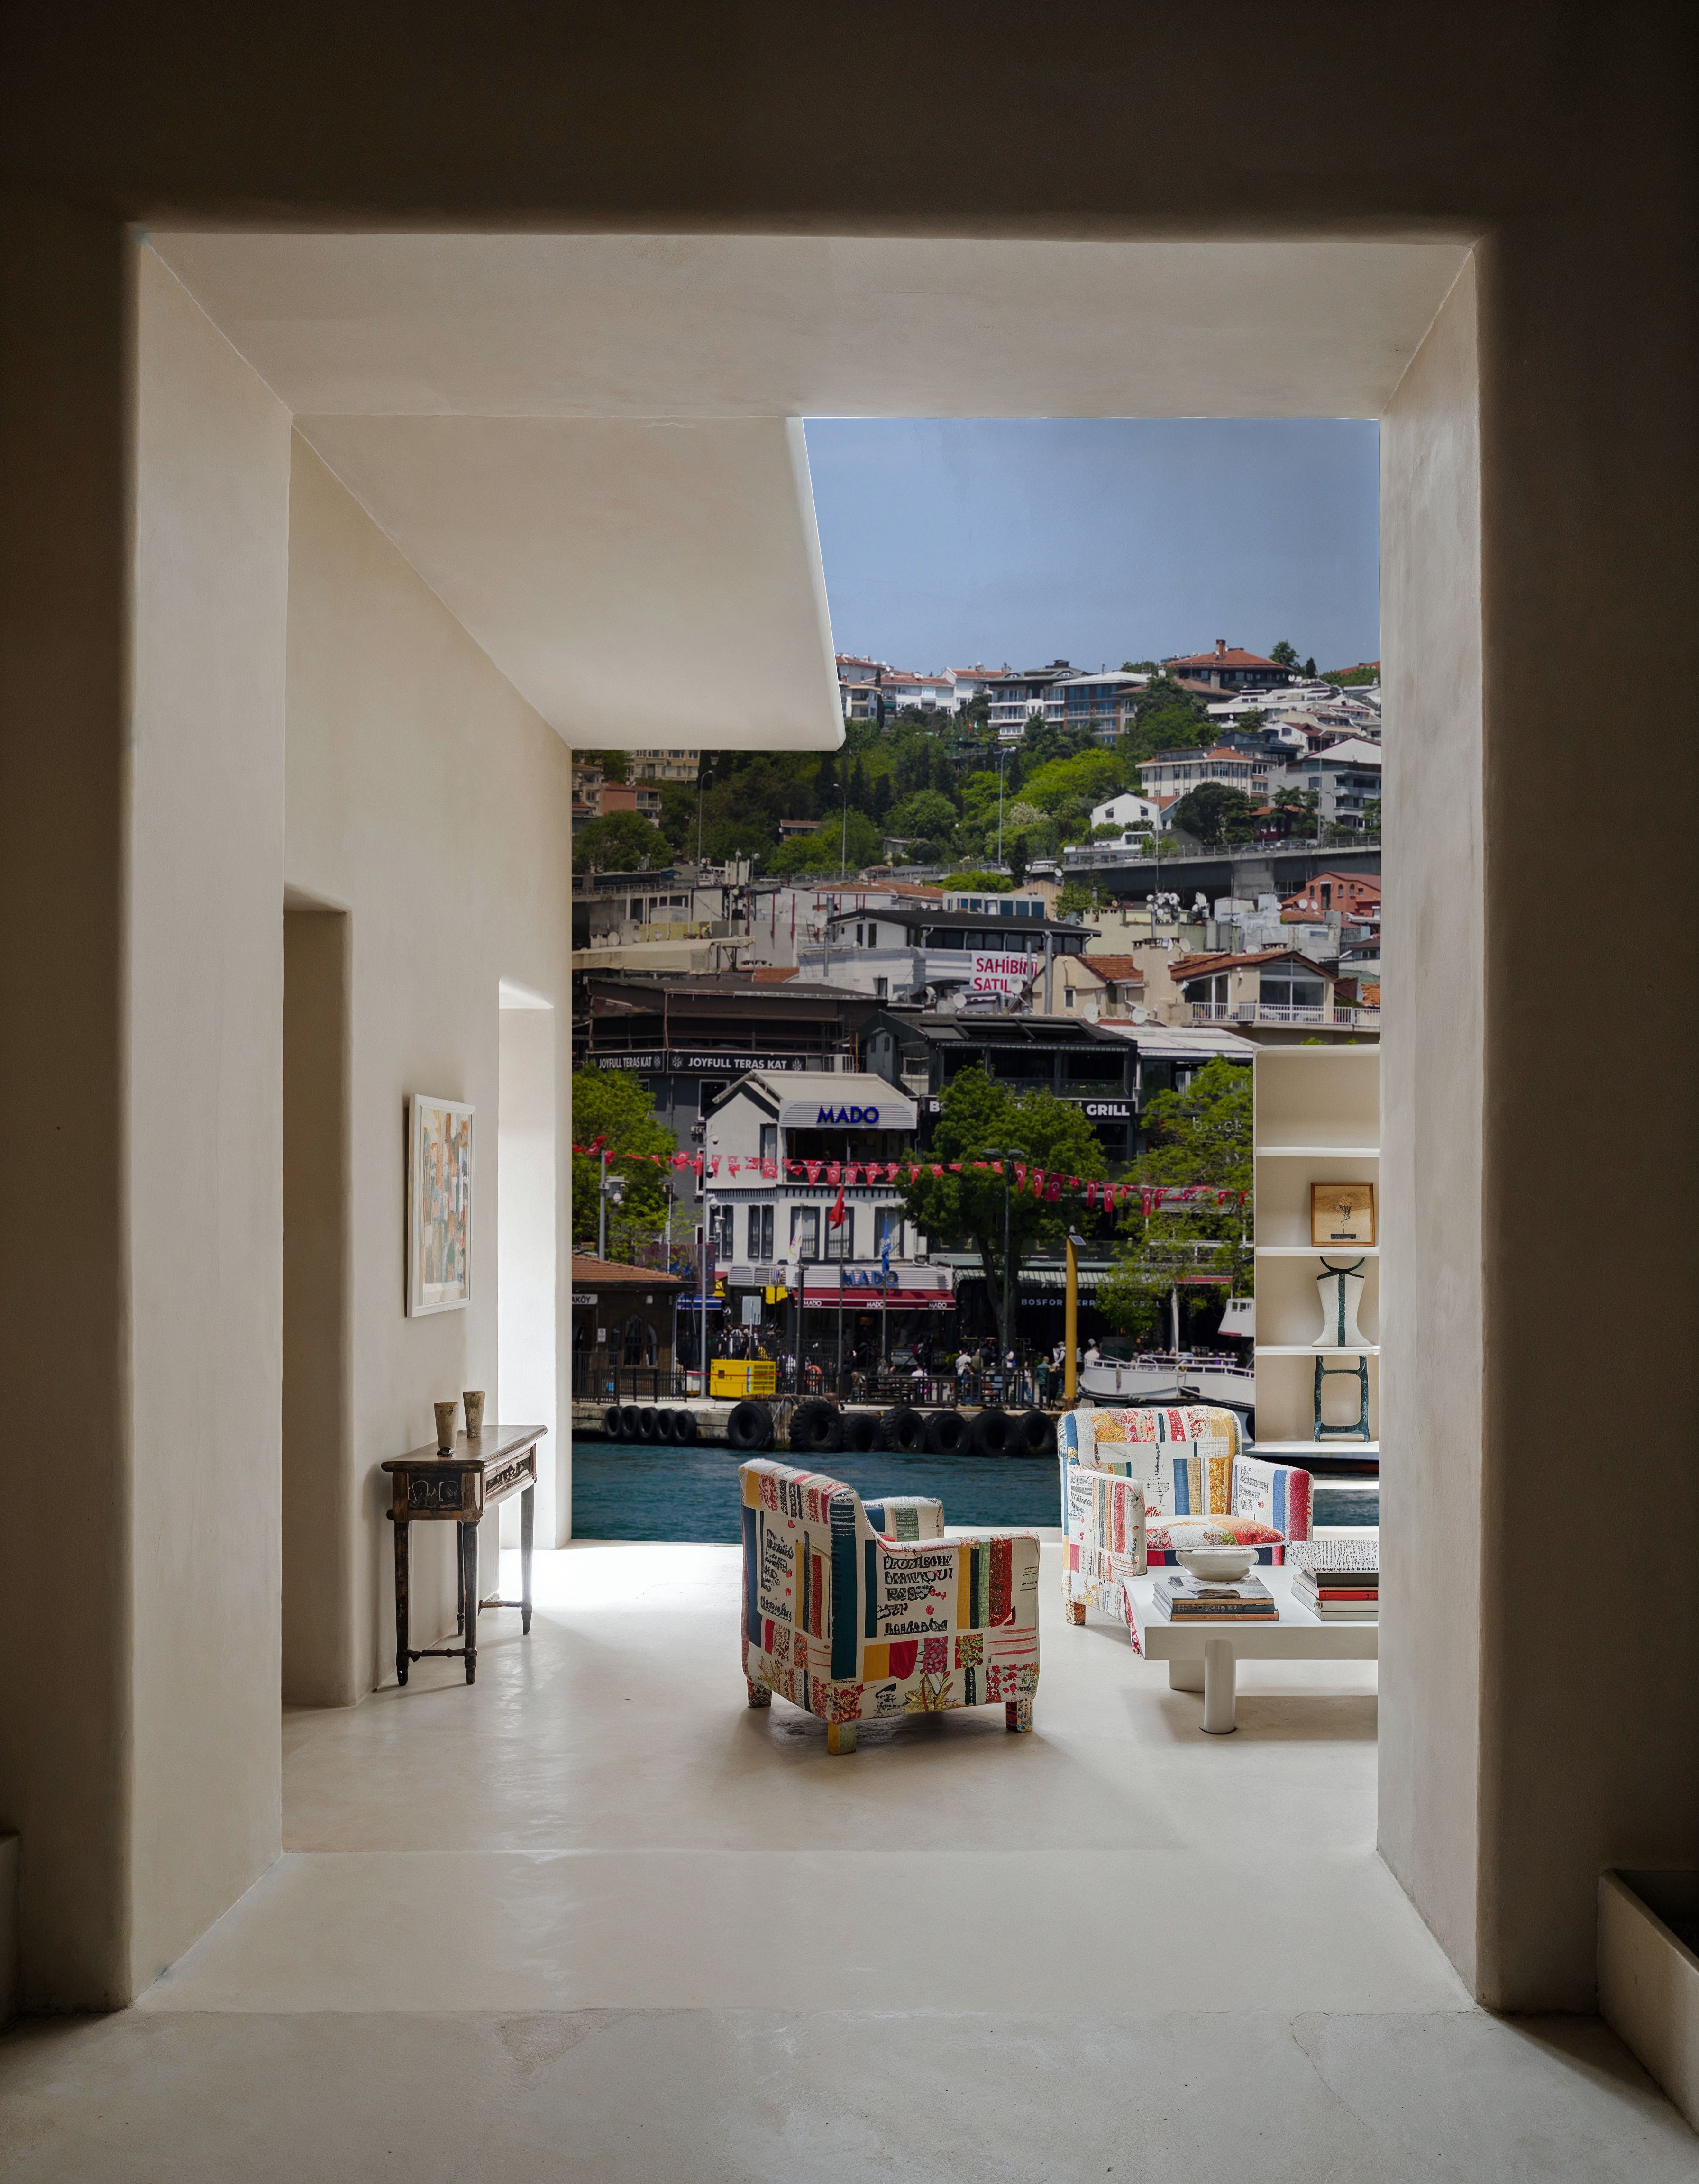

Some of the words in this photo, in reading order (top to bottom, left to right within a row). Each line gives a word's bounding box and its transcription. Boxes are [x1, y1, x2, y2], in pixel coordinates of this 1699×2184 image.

[973, 977, 1012, 993] SATIL
[599, 1058, 621, 1069] JOYFULL
[623, 1057, 639, 1067] TERAS
[640, 1056, 652, 1067] KAT
[688, 1057, 731, 1067] JOYFULL
[734, 1059, 764, 1069] TERAS
[767, 1060, 787, 1069] KAT
[816, 1105, 879, 1123] MADO
[1087, 1104, 1130, 1116] GRILL
[841, 1270, 899, 1286] MADO
[572, 1295, 591, 1303] AKÖY
